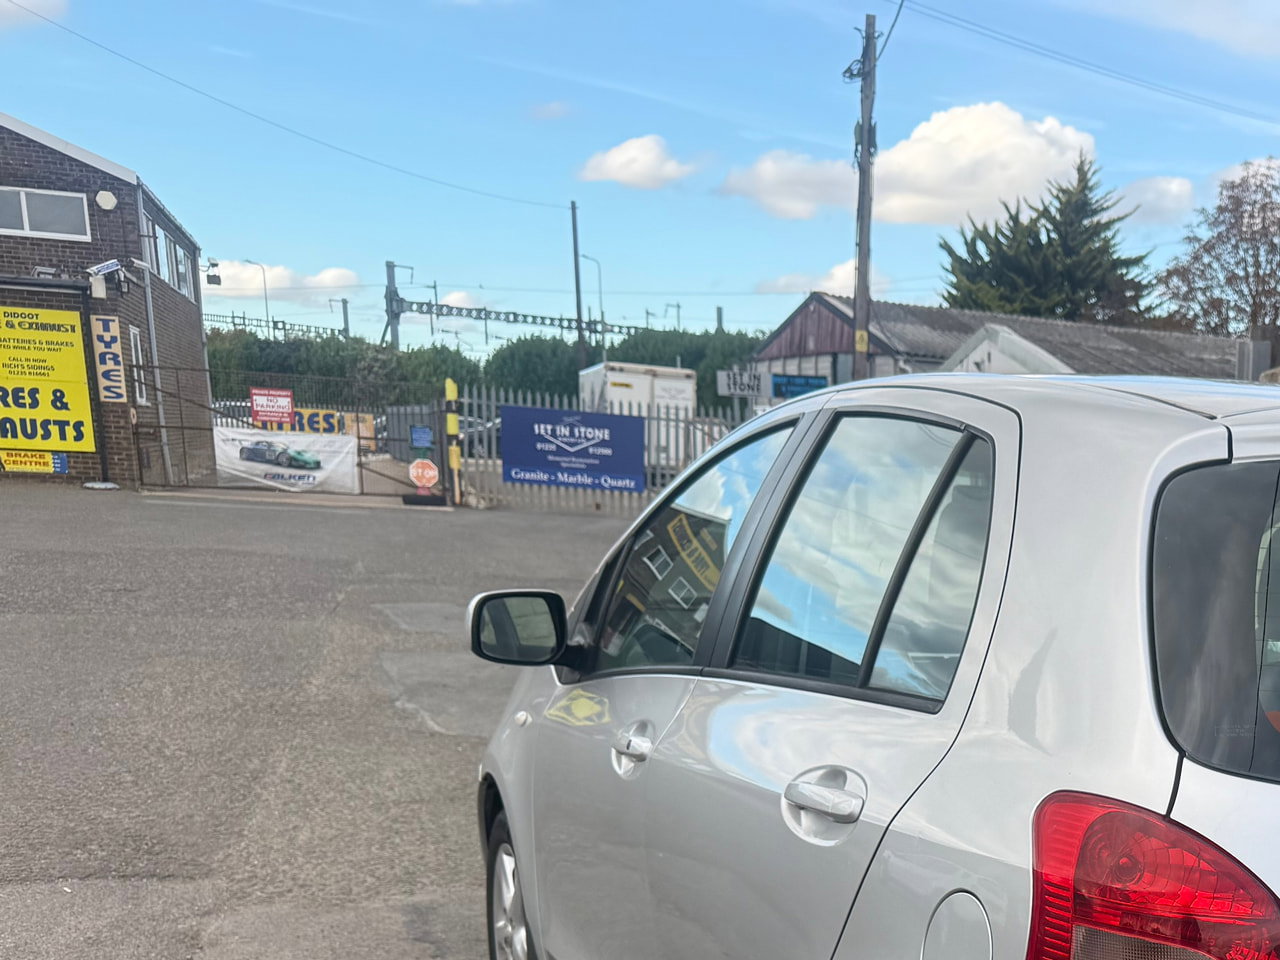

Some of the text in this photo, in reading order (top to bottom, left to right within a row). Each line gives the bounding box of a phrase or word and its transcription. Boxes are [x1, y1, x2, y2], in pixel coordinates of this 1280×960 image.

[95, 318, 125, 400] TYRES
[51, 388, 71, 411] &
[534, 423, 553, 435] SET
[556, 425, 570, 437] IN
[574, 427, 611, 441] STONE
[4, 459, 50, 468] CENTRE
[6, 452, 46, 460] BRAKE
[511, 468, 549, 482] Granite
[556, 471, 594, 486] Marble
[600, 475, 636, 489] Quartz
